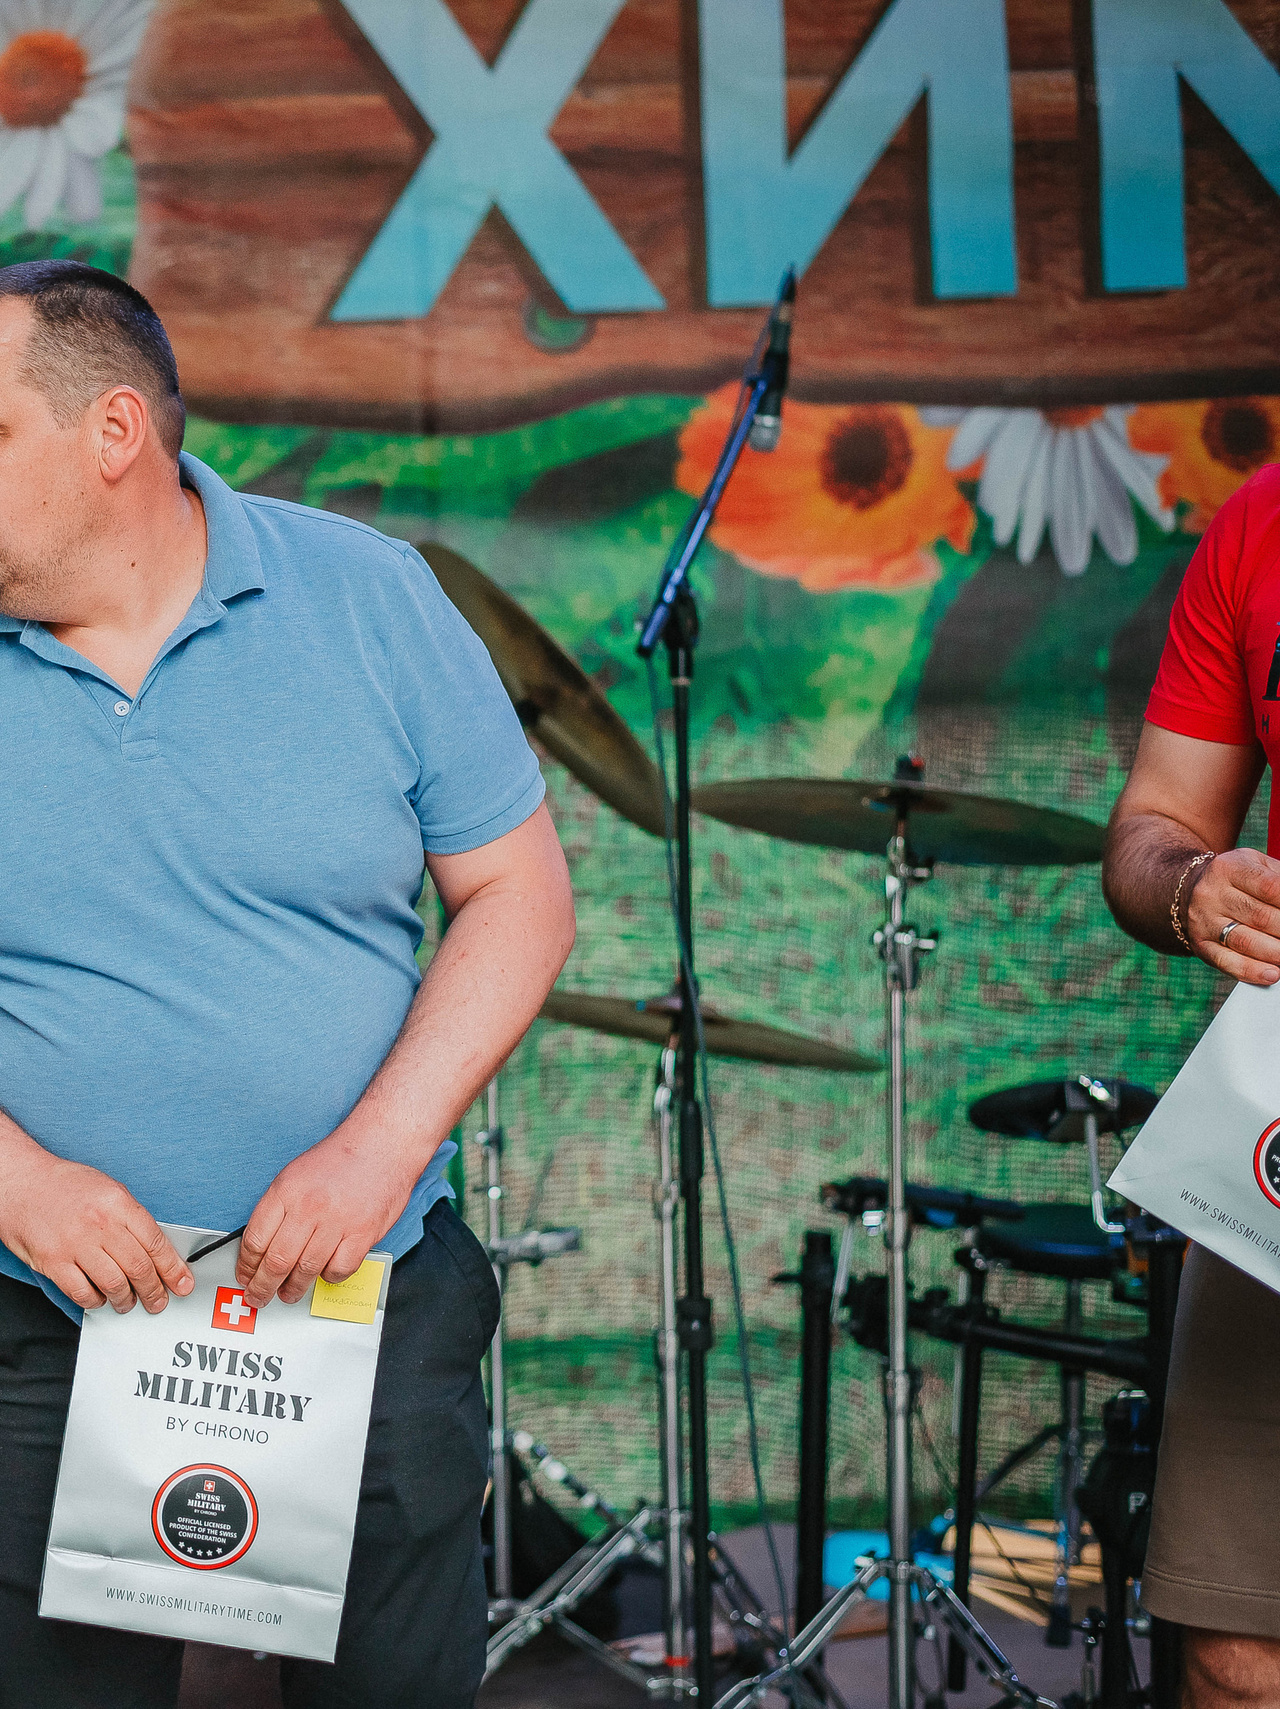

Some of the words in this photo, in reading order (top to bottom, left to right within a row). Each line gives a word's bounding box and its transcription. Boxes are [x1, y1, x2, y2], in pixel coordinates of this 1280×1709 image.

[1180, 1188, 1280, 1258] WWW.SWISSMILITA
[172, 1340, 284, 1382] SWISS
[133, 1370, 313, 1422] MILITARY
[166, 1416, 189, 1432] BY
[194, 1421, 269, 1445] CHRONO
[187, 1498, 227, 1512] MILITARY
[195, 1492, 221, 1503] SWISS
[169, 1522, 197, 1532] PRODUCT
[207, 1528, 219, 1536] THE
[219, 1530, 238, 1539] SWISS
[177, 1516, 203, 1526] OFFICIAL
[203, 1520, 232, 1531] LICENSED
[178, 1531, 227, 1544] CONFEDERATION
[106, 1586, 283, 1626] WWW.SWISSMILITARYTIME.COM
